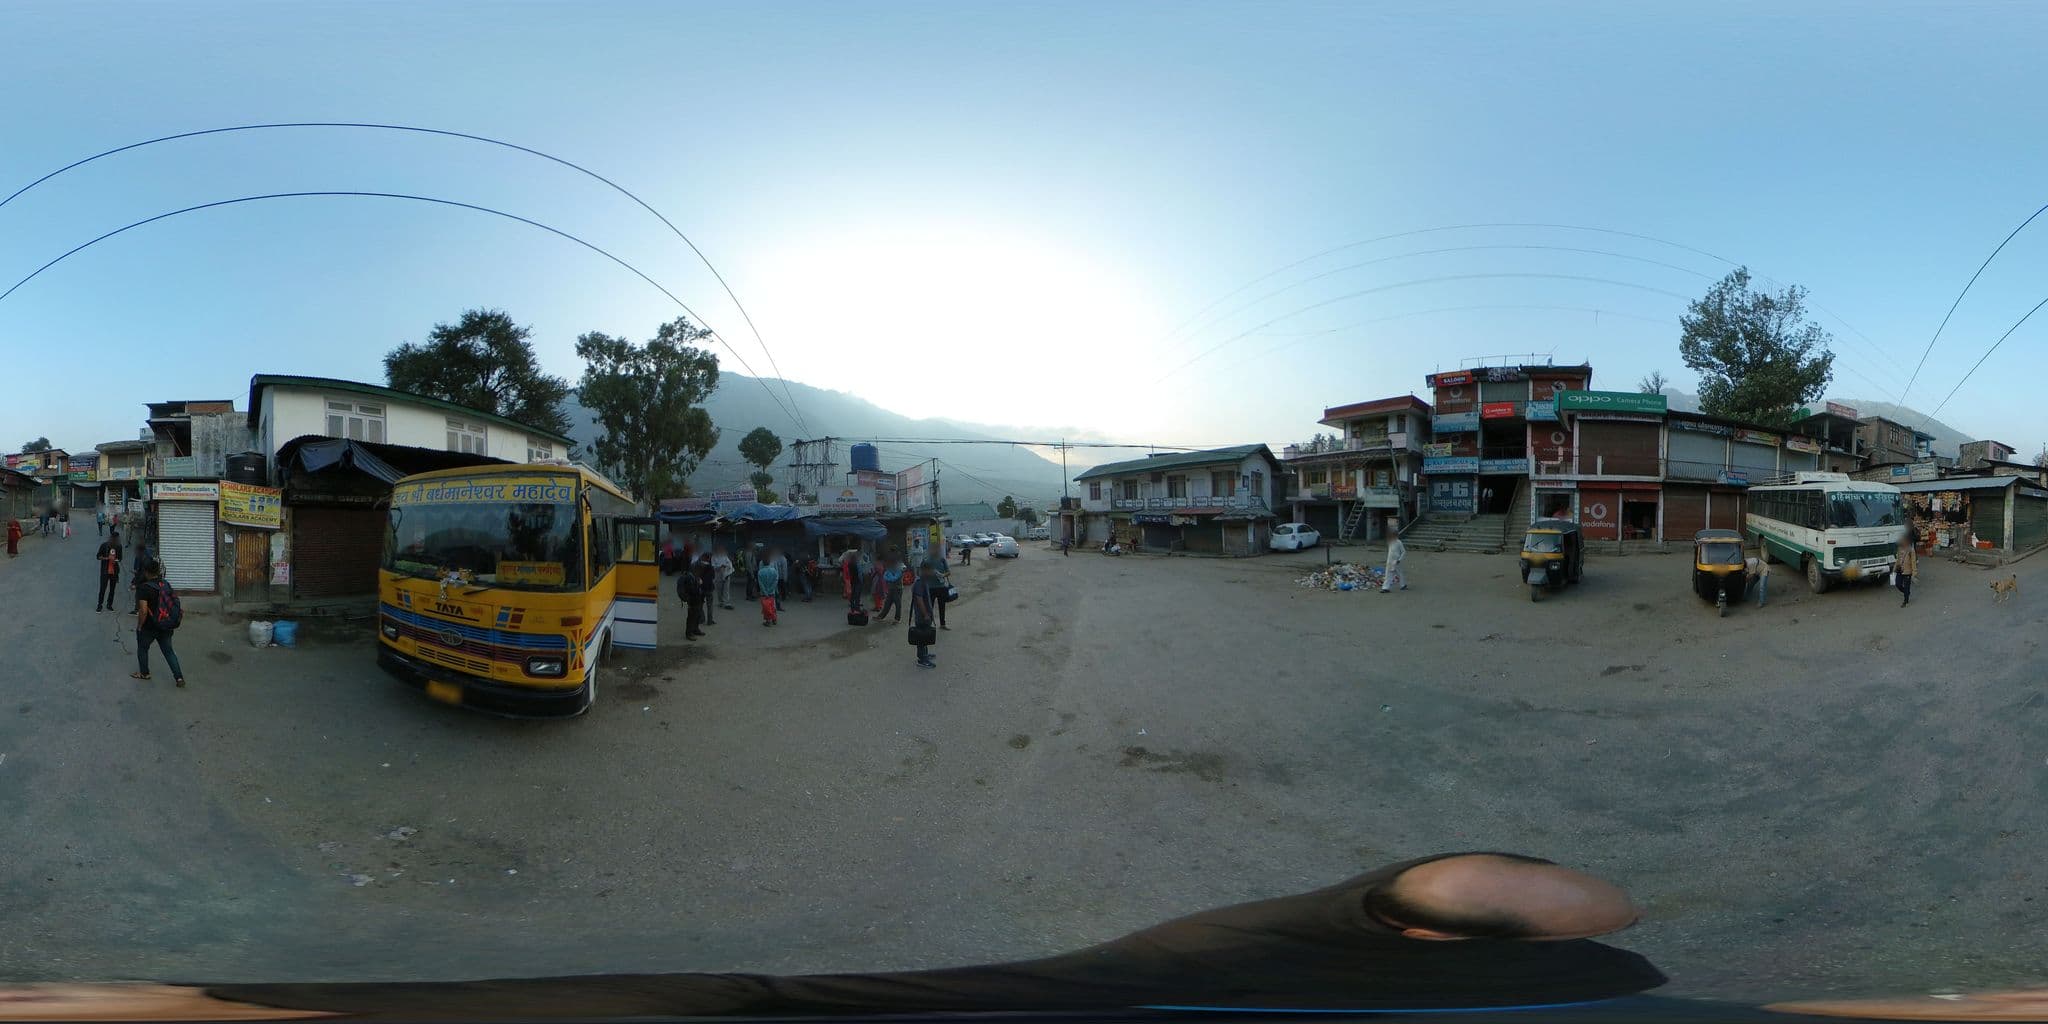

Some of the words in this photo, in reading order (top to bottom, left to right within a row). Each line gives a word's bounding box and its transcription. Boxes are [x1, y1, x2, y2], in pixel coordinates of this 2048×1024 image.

[1567, 395, 1612, 403] oppo
[512, 479, 573, 502] महादेव
[1582, 519, 1616, 529] vodafone
[435, 602, 463, 615] TATA
